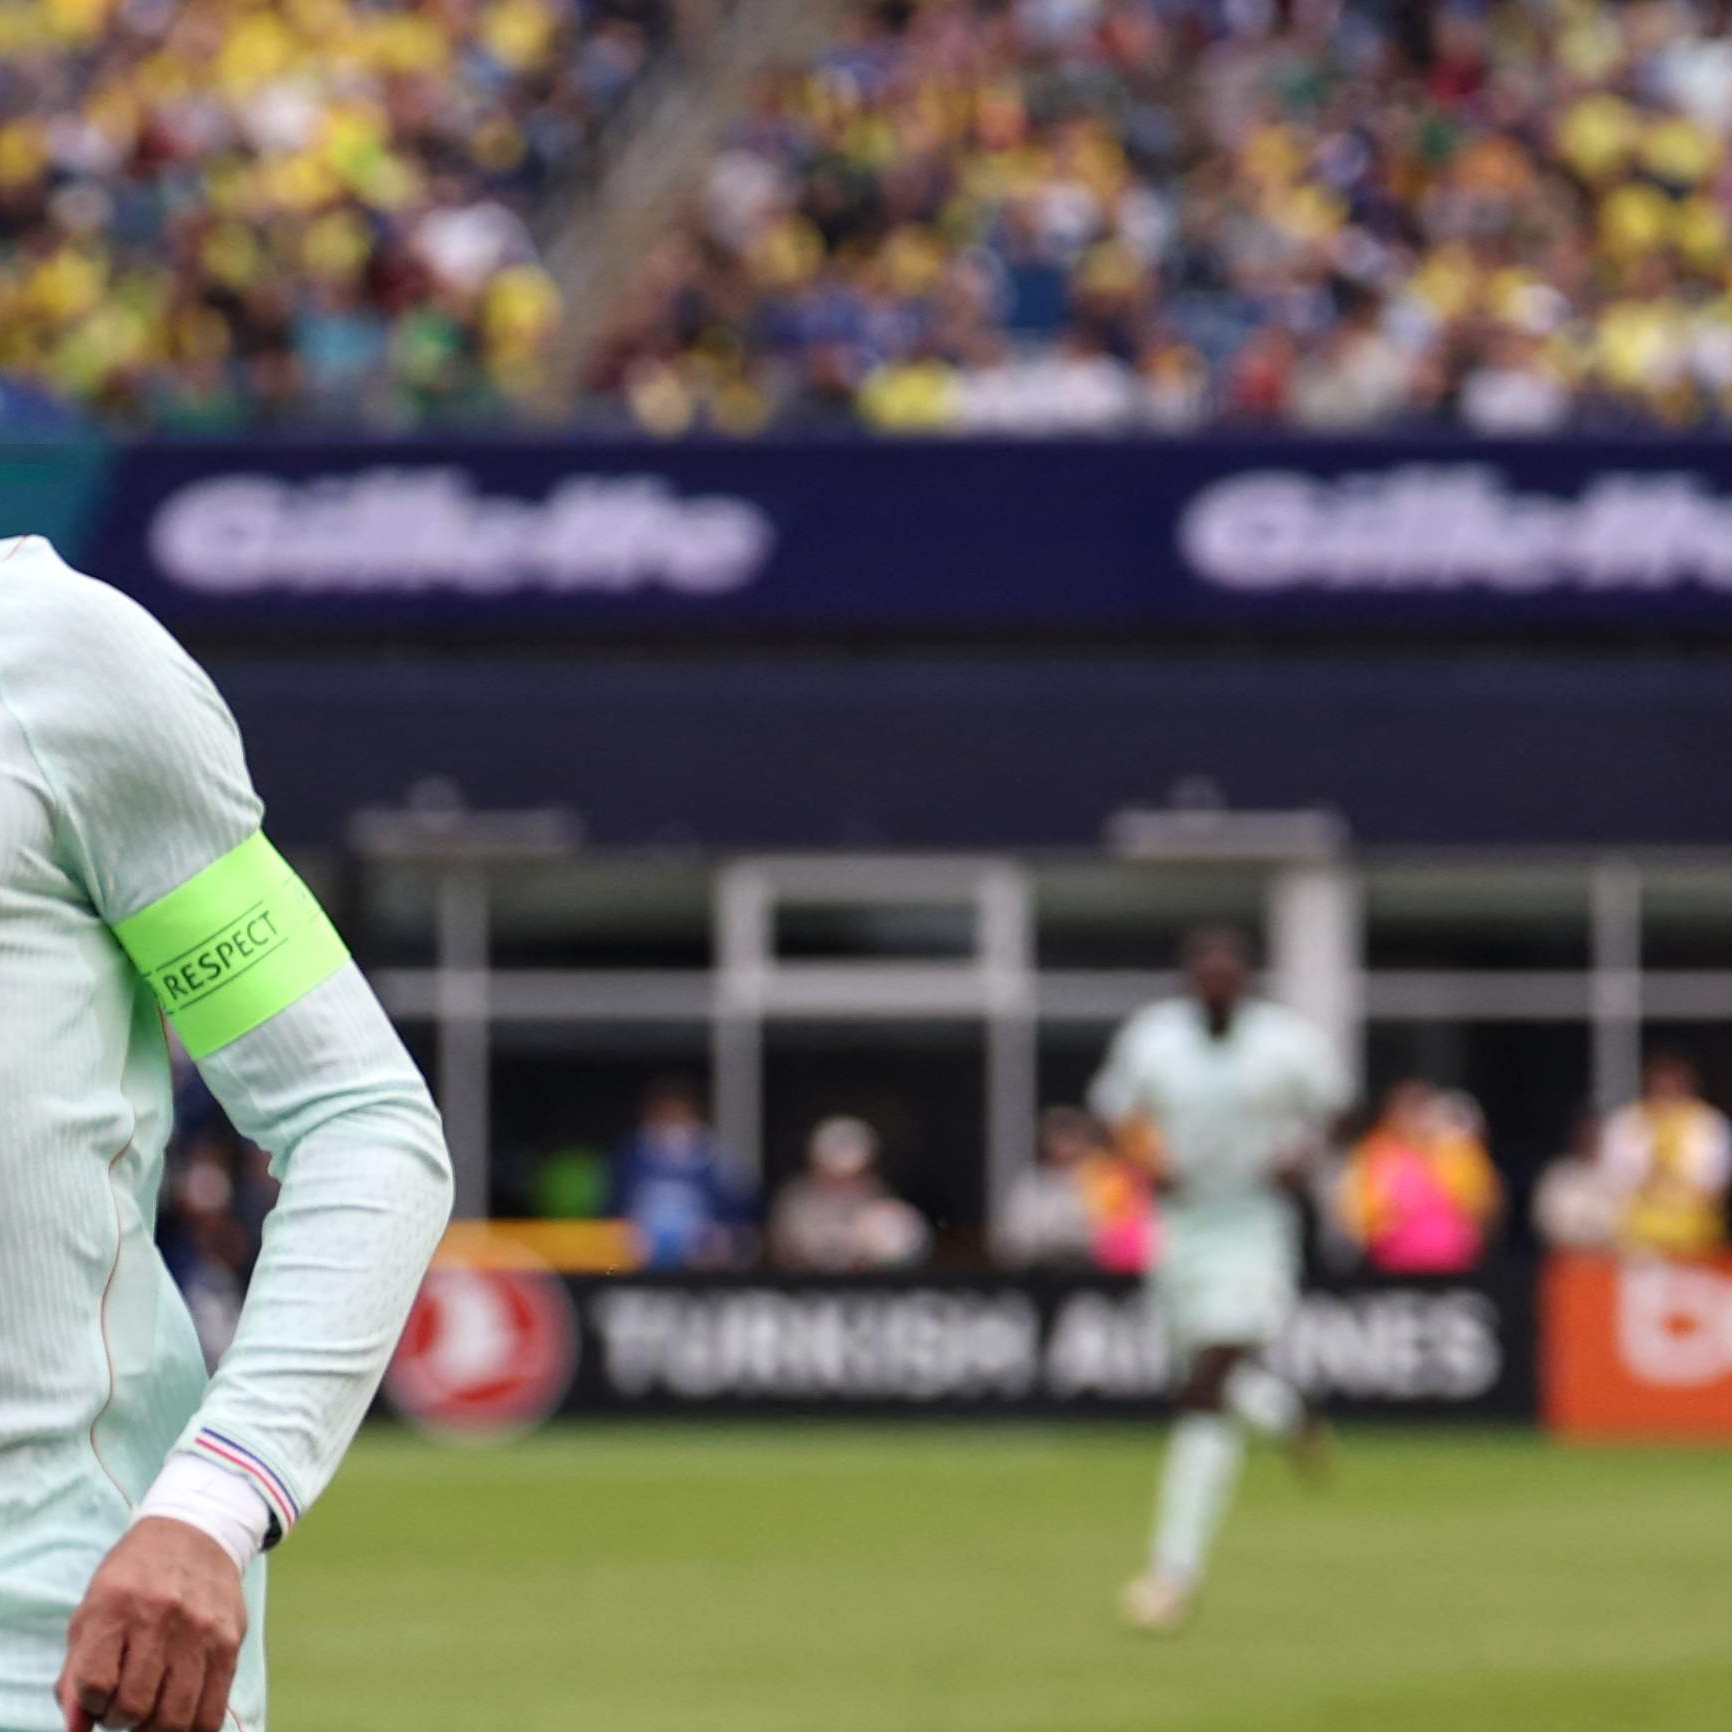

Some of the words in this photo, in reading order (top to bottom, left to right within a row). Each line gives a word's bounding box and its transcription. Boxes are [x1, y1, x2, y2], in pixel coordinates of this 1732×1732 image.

[148, 468, 775, 594] Gillette
[162, 909, 280, 1000] RESPECT
[597, 1292, 1037, 1394] TURKISH
